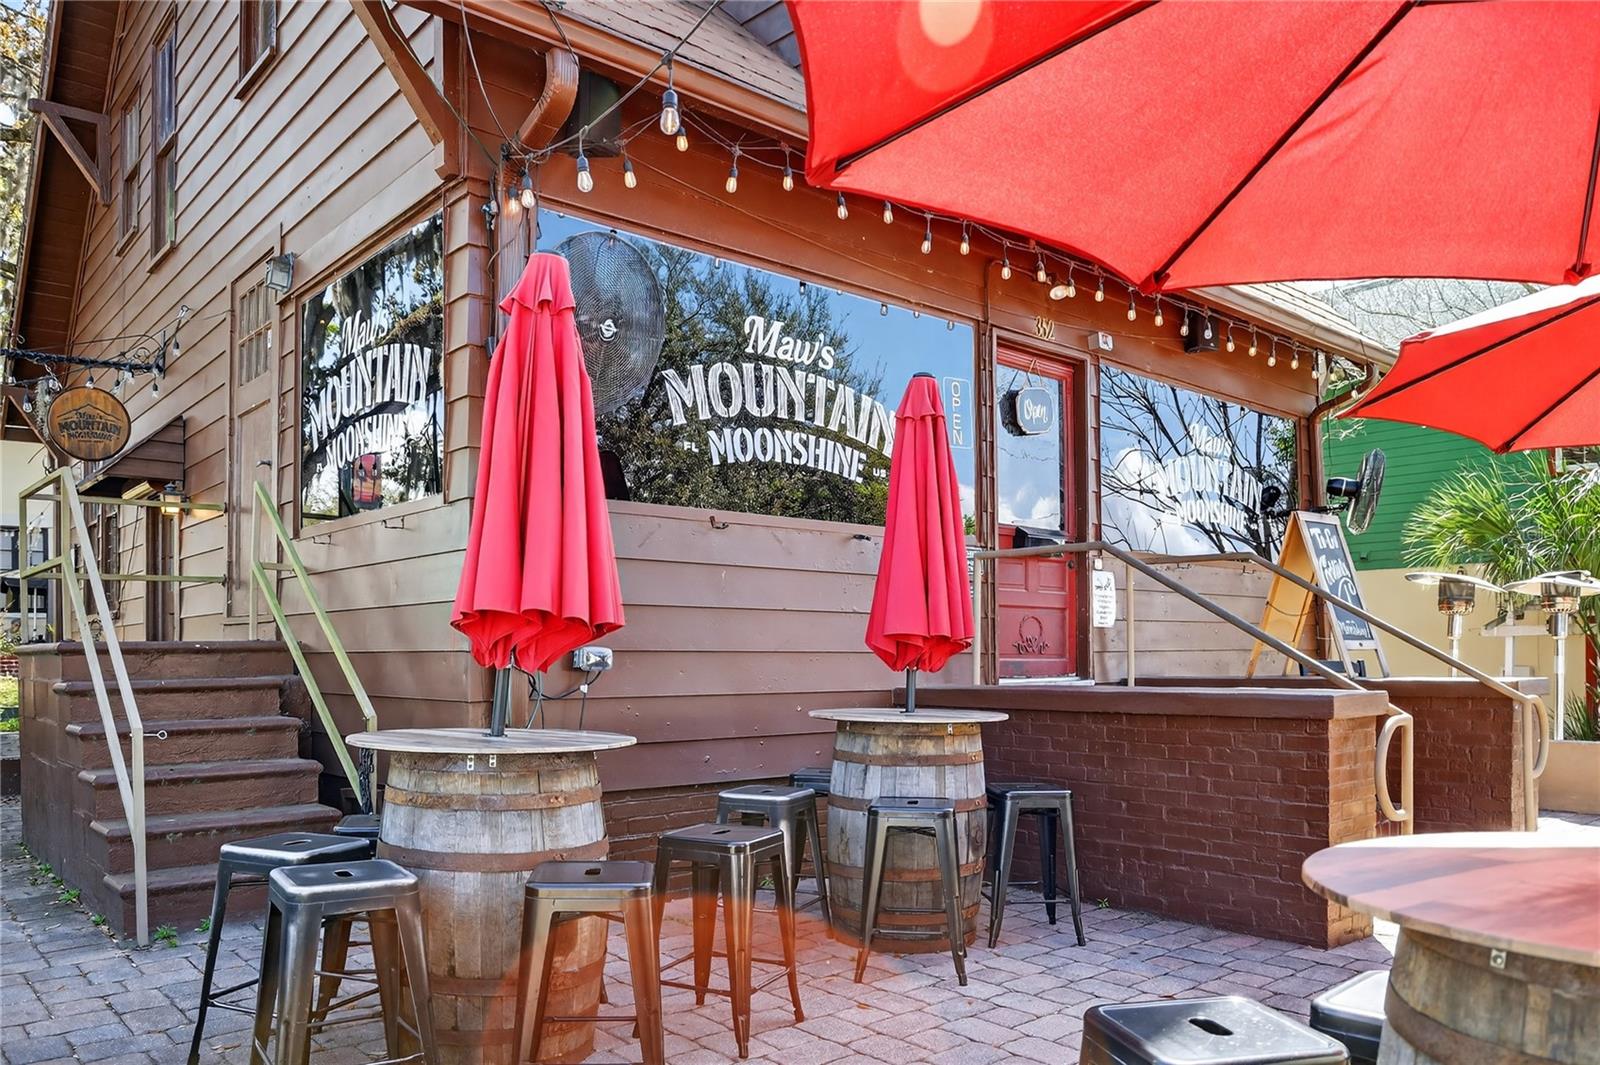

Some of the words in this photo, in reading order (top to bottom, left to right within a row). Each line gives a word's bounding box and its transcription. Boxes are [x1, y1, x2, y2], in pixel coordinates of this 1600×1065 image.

[342, 308, 388, 358] Maw's
[744, 315, 834, 370] Maw's
[1035, 316, 1055, 340] 352
[307, 342, 431, 453] MOUNTAIN
[661, 361, 895, 459] MOUNTAIN
[951, 381, 963, 445] OPEN
[1024, 398, 1048, 424] Open
[684, 441, 699, 453] FL
[707, 426, 867, 484] MOONSHINE
[872, 467, 887, 478] US
